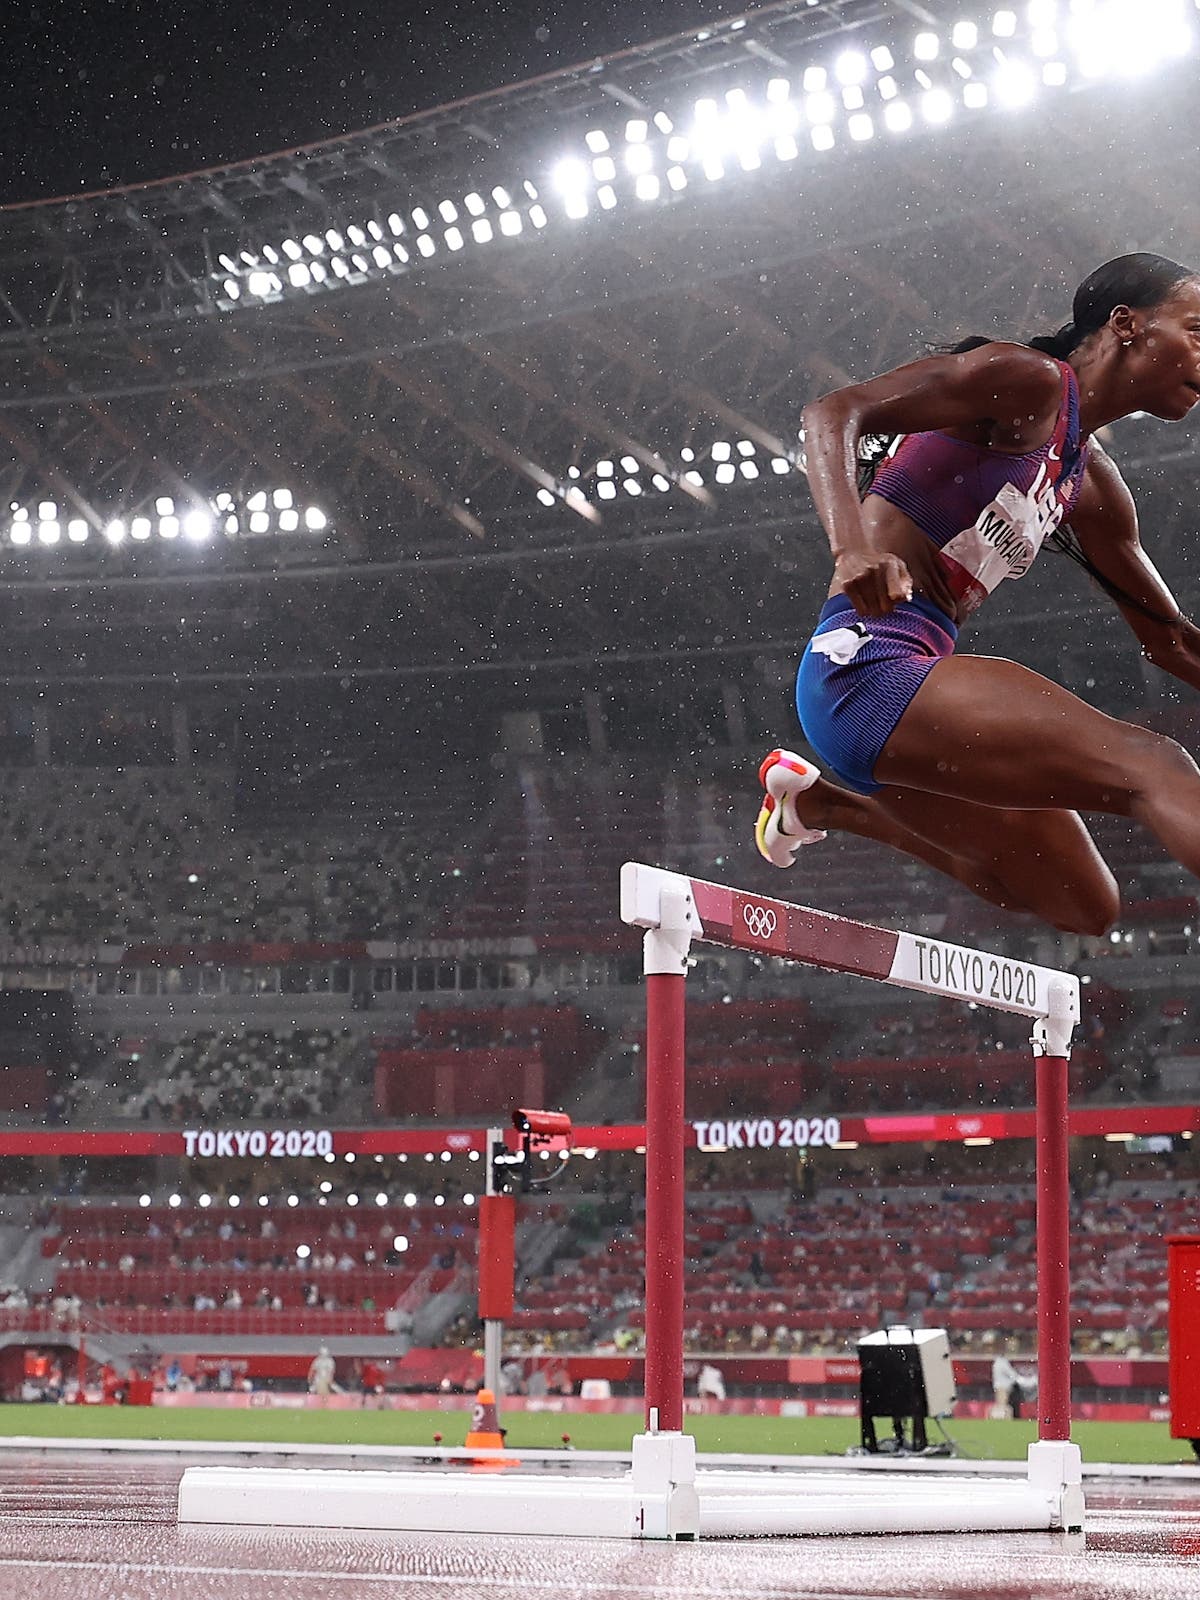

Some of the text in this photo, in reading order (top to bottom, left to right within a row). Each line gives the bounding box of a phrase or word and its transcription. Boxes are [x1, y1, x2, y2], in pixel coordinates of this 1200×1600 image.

[915, 941, 1036, 1007] TOKYO 2020
[182, 1130, 332, 1157] TOKYO 2020
[692, 1117, 840, 1149] TOKYO 2020
